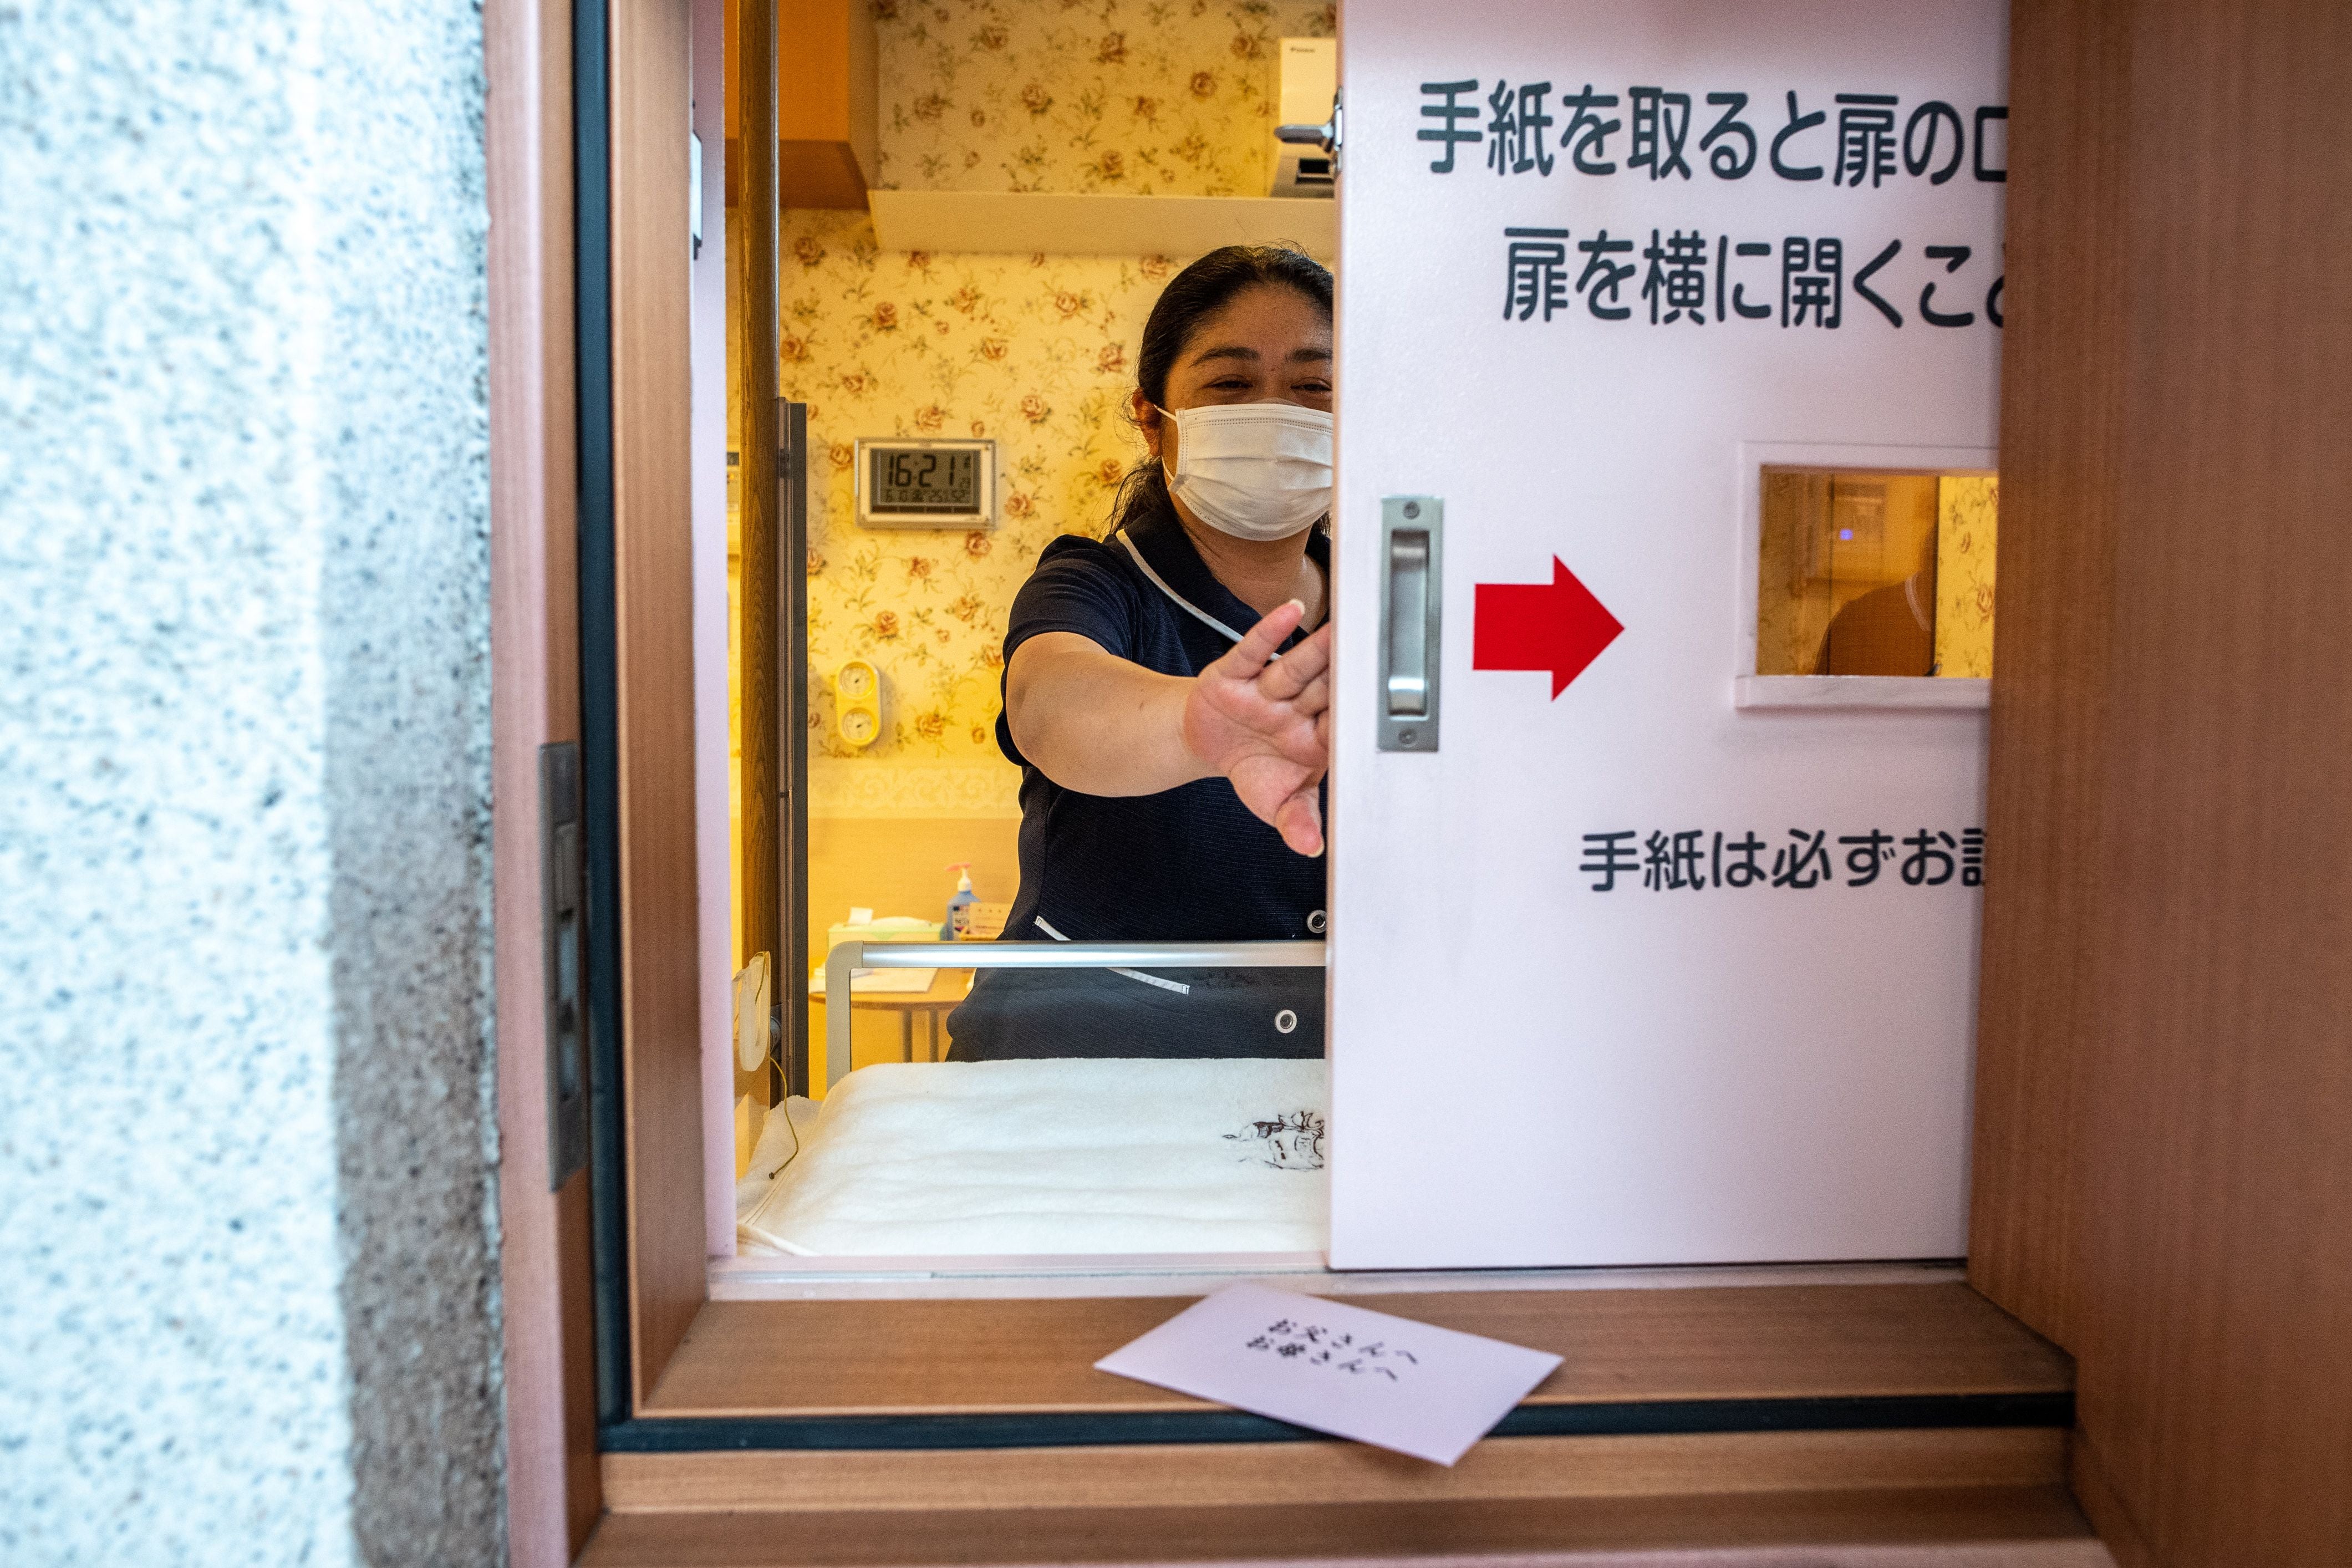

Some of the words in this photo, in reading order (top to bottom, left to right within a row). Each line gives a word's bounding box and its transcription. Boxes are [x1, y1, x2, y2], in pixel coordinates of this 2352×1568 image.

[1503, 227, 2005, 329] 扉を横に開くこ
[888, 454, 955, 487] 16:21
